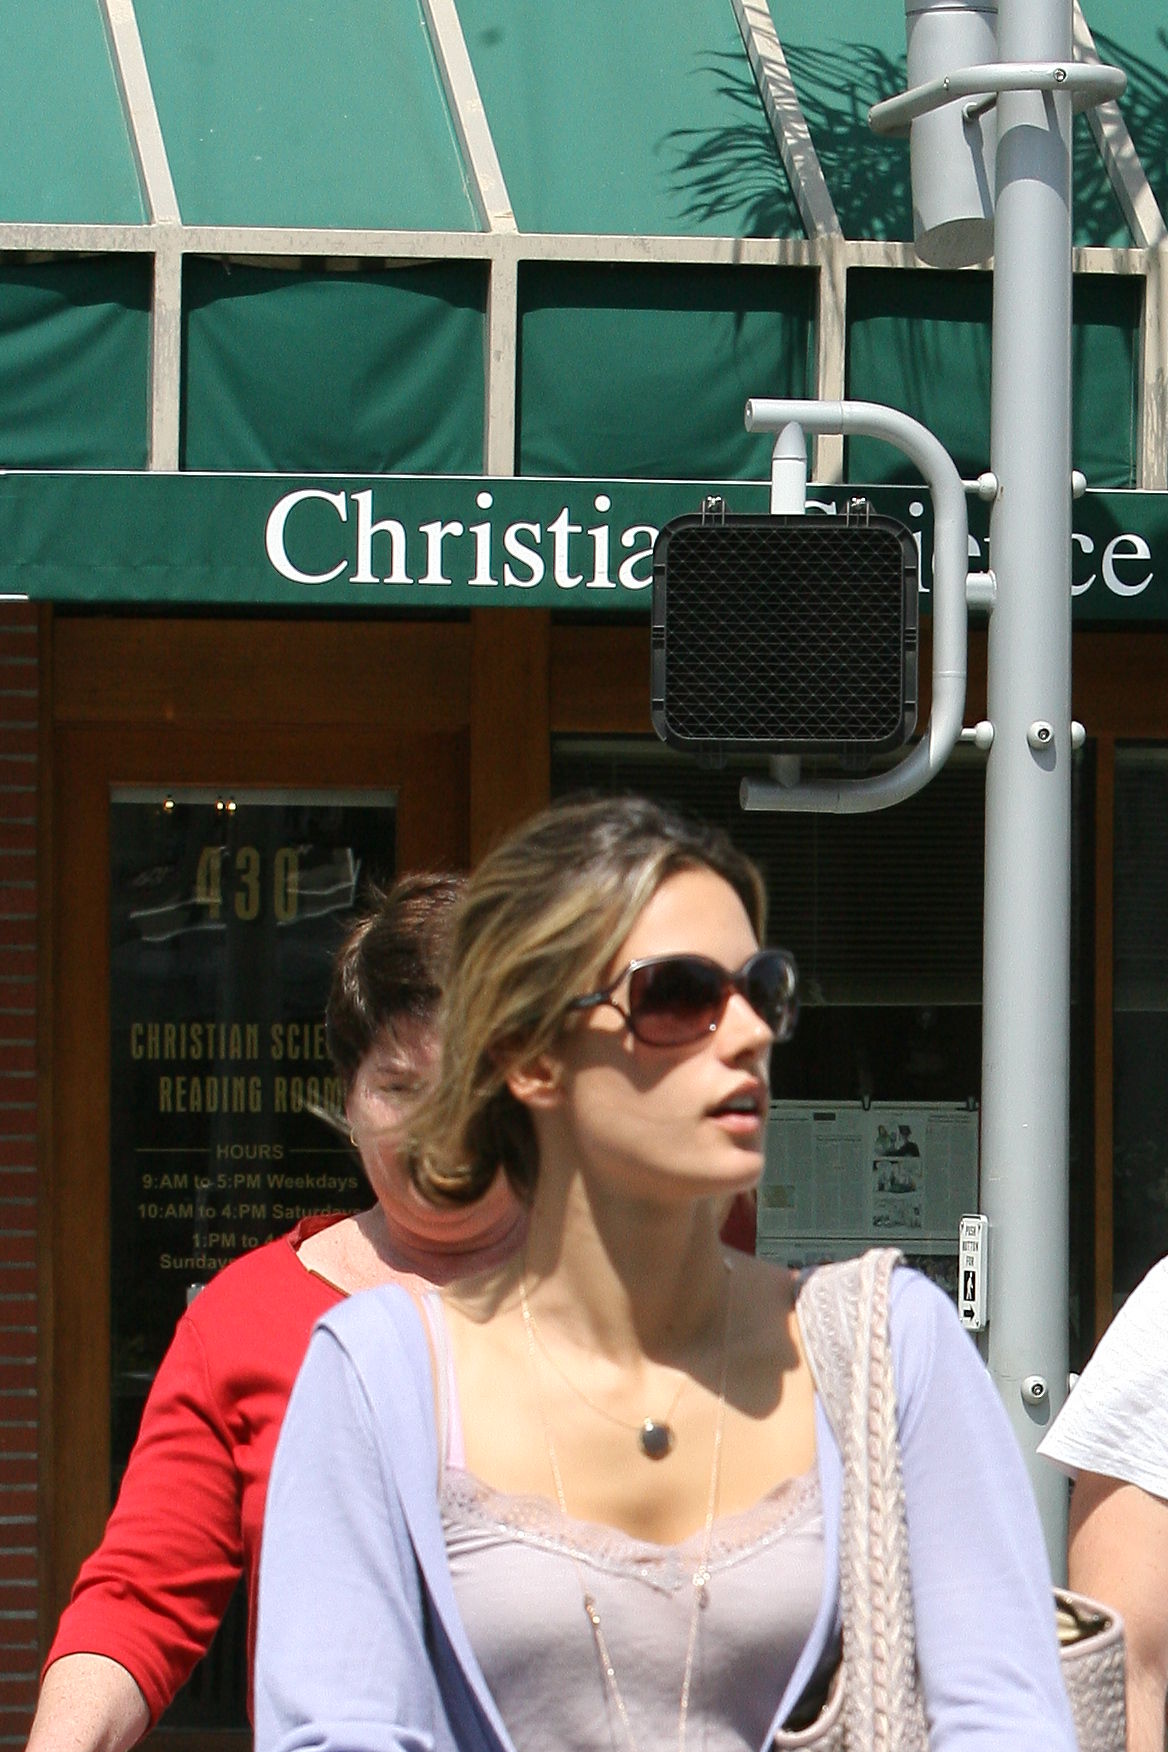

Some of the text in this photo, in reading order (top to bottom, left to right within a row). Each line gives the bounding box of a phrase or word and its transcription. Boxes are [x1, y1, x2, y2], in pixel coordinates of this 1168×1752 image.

[265, 489, 656, 590] Christia
[196, 846, 300, 921] 430
[130, 1023, 327, 1060] CHRISTIAN SCIE
[159, 1076, 341, 1113] READING ROOM
[216, 1144, 284, 1160] HOURS
[142, 1174, 358, 1192] 9:AM to 5:PM Weekdays
[138, 1204, 193, 1218] 10:AM
[200, 1204, 215, 1218] to
[221, 1204, 266, 1219] 4:PM
[192, 1233, 236, 1248] 1:PM
[241, 1234, 259, 1248] to
[160, 1254, 232, 1269] Sunday
